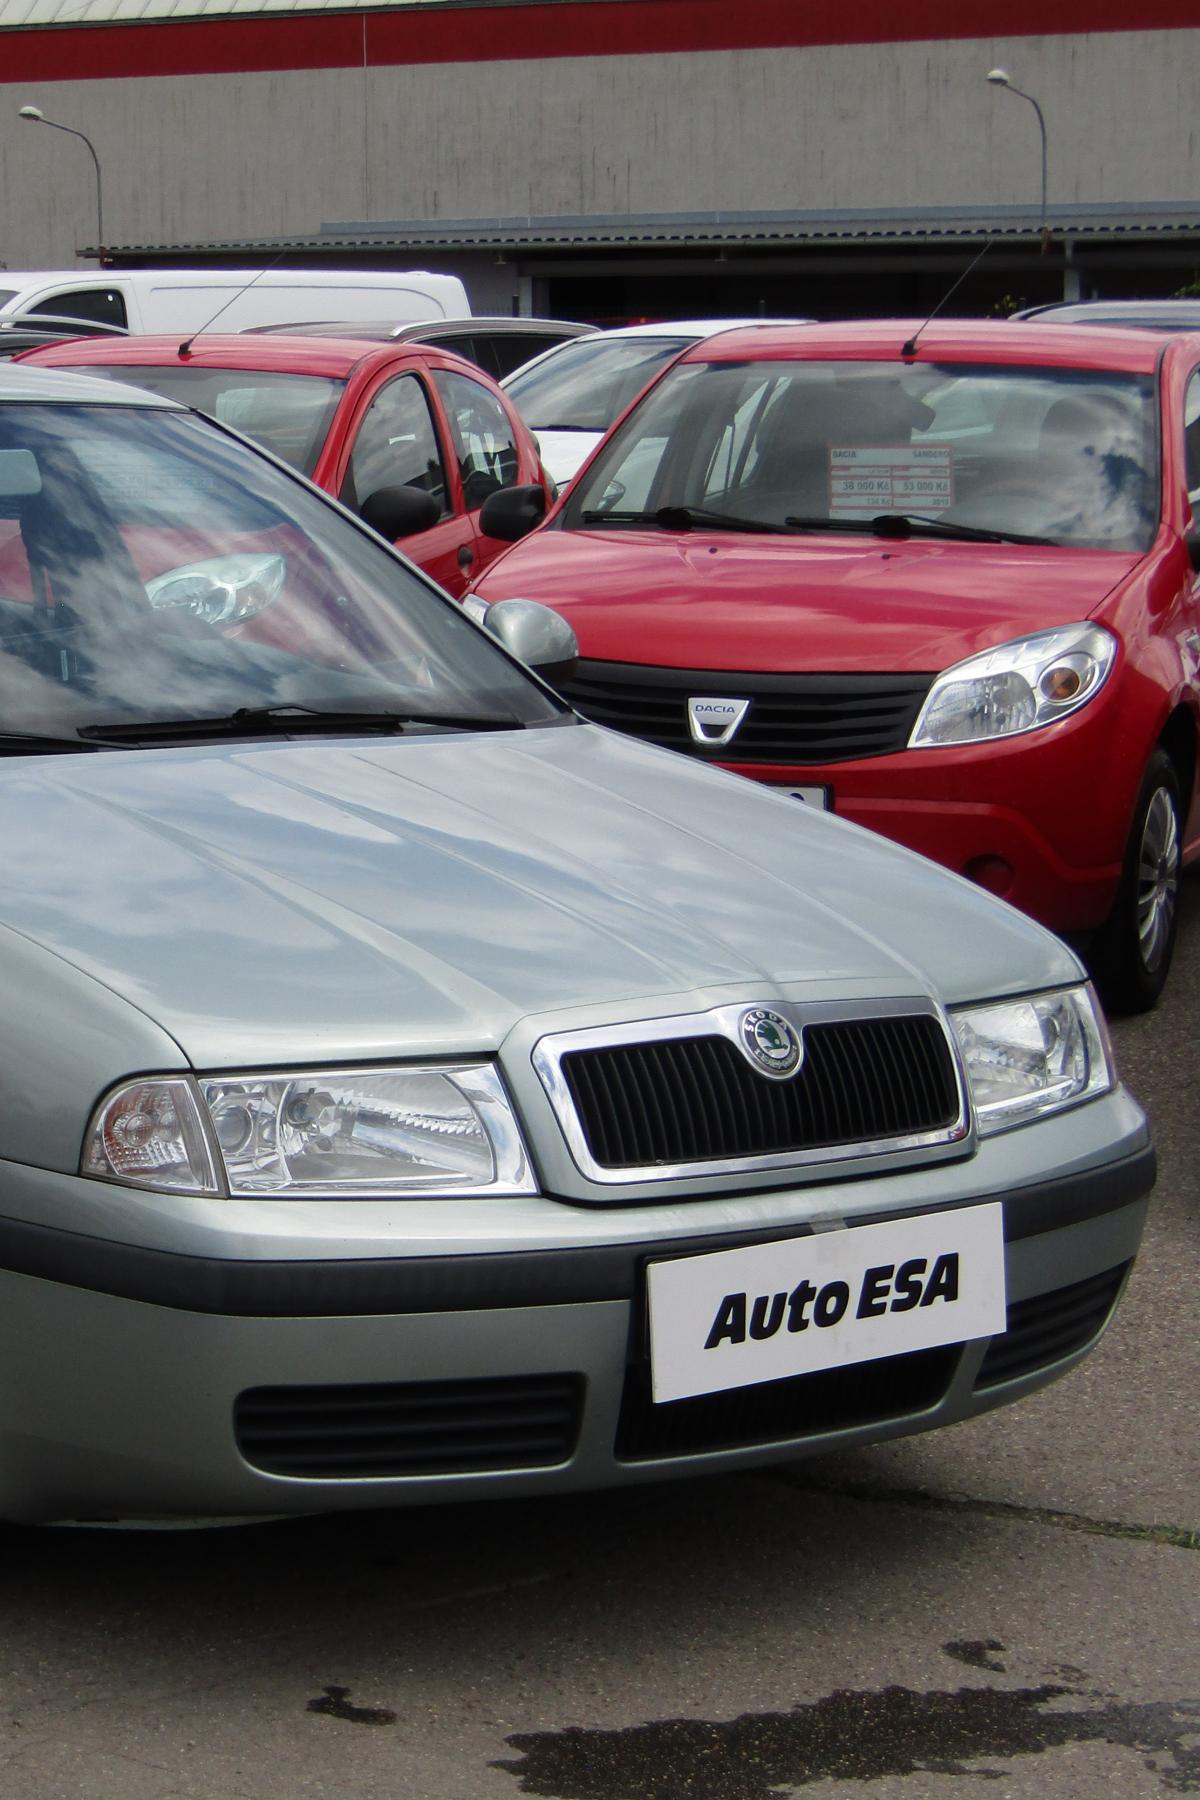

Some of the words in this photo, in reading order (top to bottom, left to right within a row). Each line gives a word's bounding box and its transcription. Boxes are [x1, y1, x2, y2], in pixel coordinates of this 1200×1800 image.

[695, 704, 736, 713] DACIA
[703, 1279, 850, 1350] Auto
[855, 1252, 959, 1320] ESA
